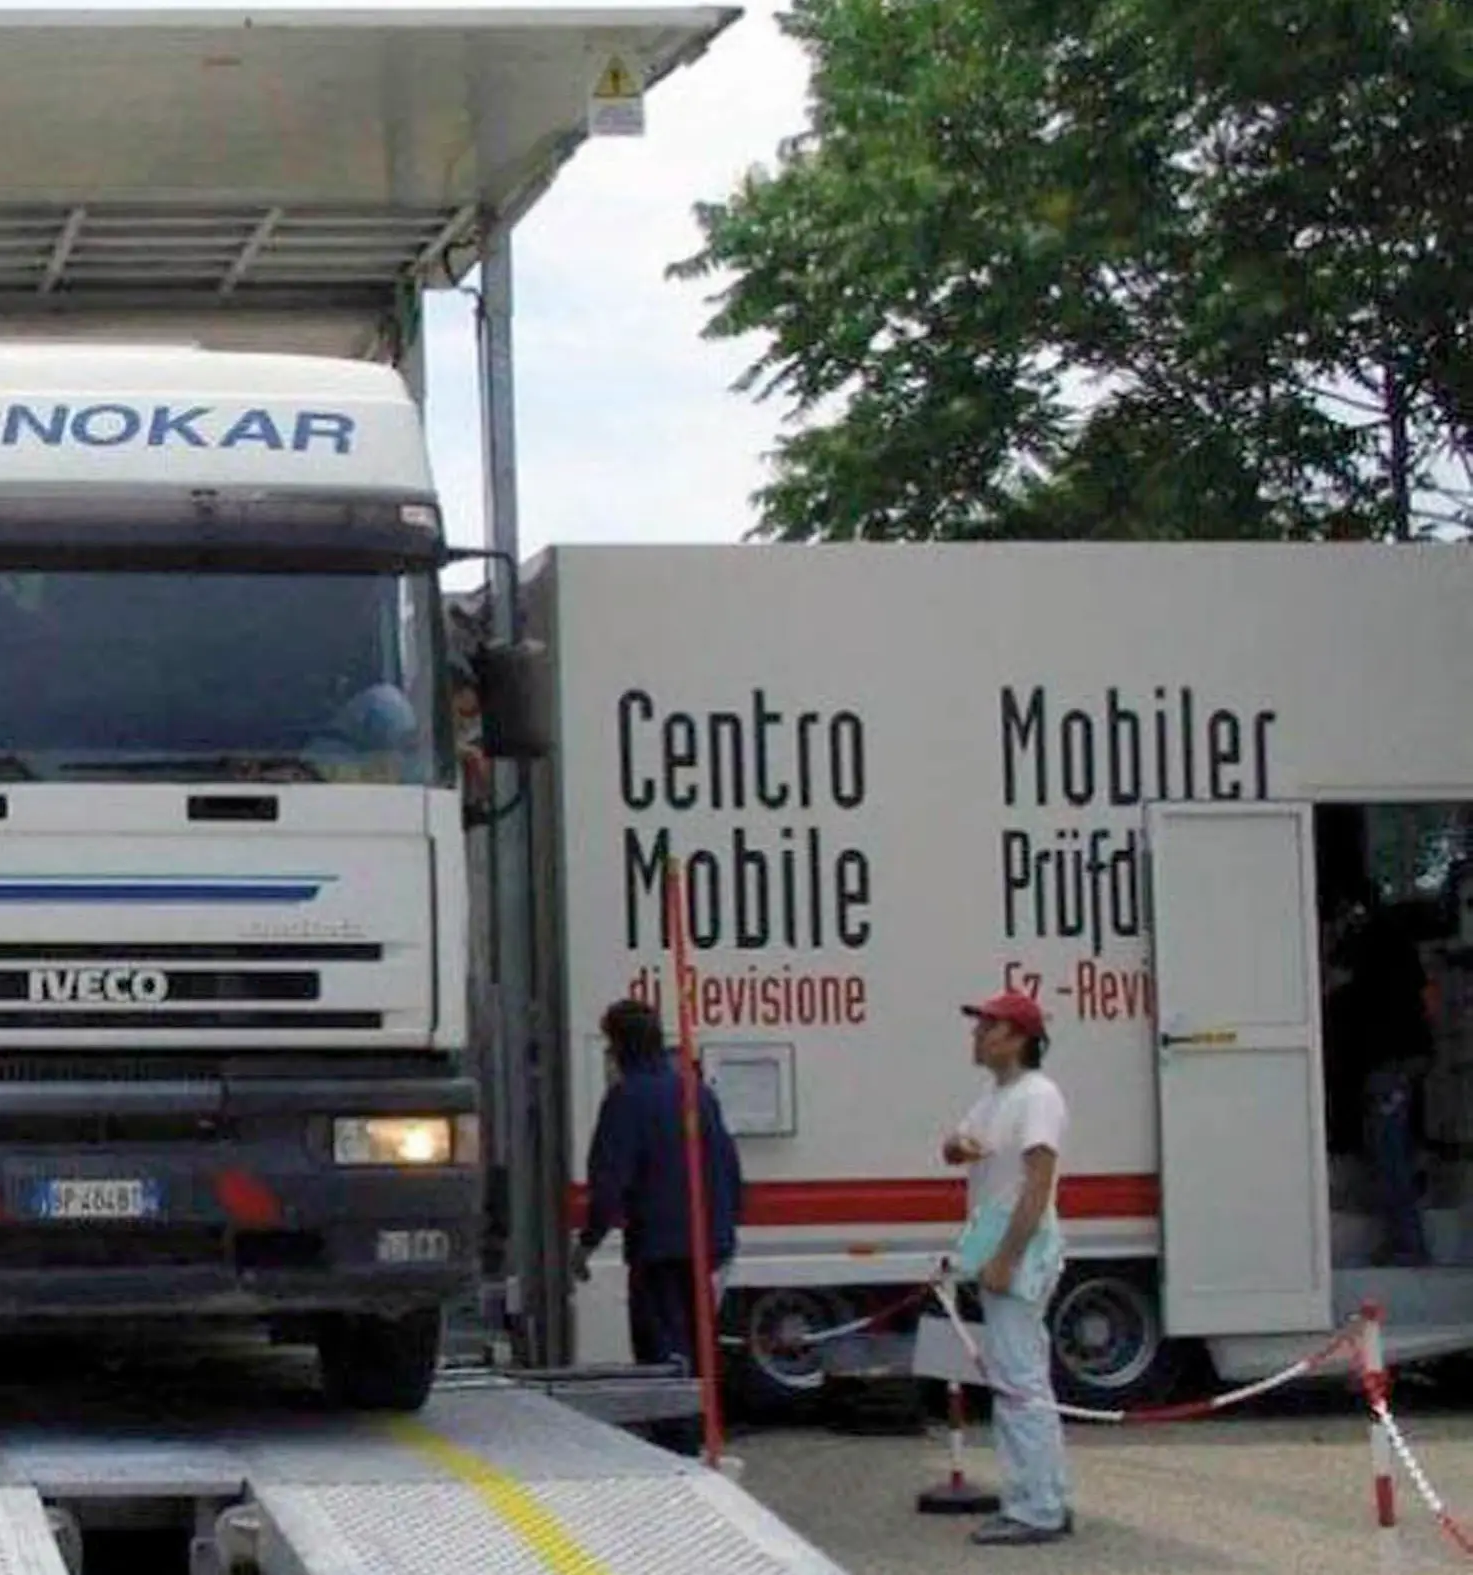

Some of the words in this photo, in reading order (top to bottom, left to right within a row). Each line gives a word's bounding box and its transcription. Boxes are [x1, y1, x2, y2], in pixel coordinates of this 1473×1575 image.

[619, 688, 864, 809] Centro
[1001, 685, 1276, 806] Mobiler
[624, 827, 870, 949] Mobile
[29, 968, 169, 1001] IVECO
[630, 966, 661, 1014] di
[677, 963, 866, 1026] Revisione
